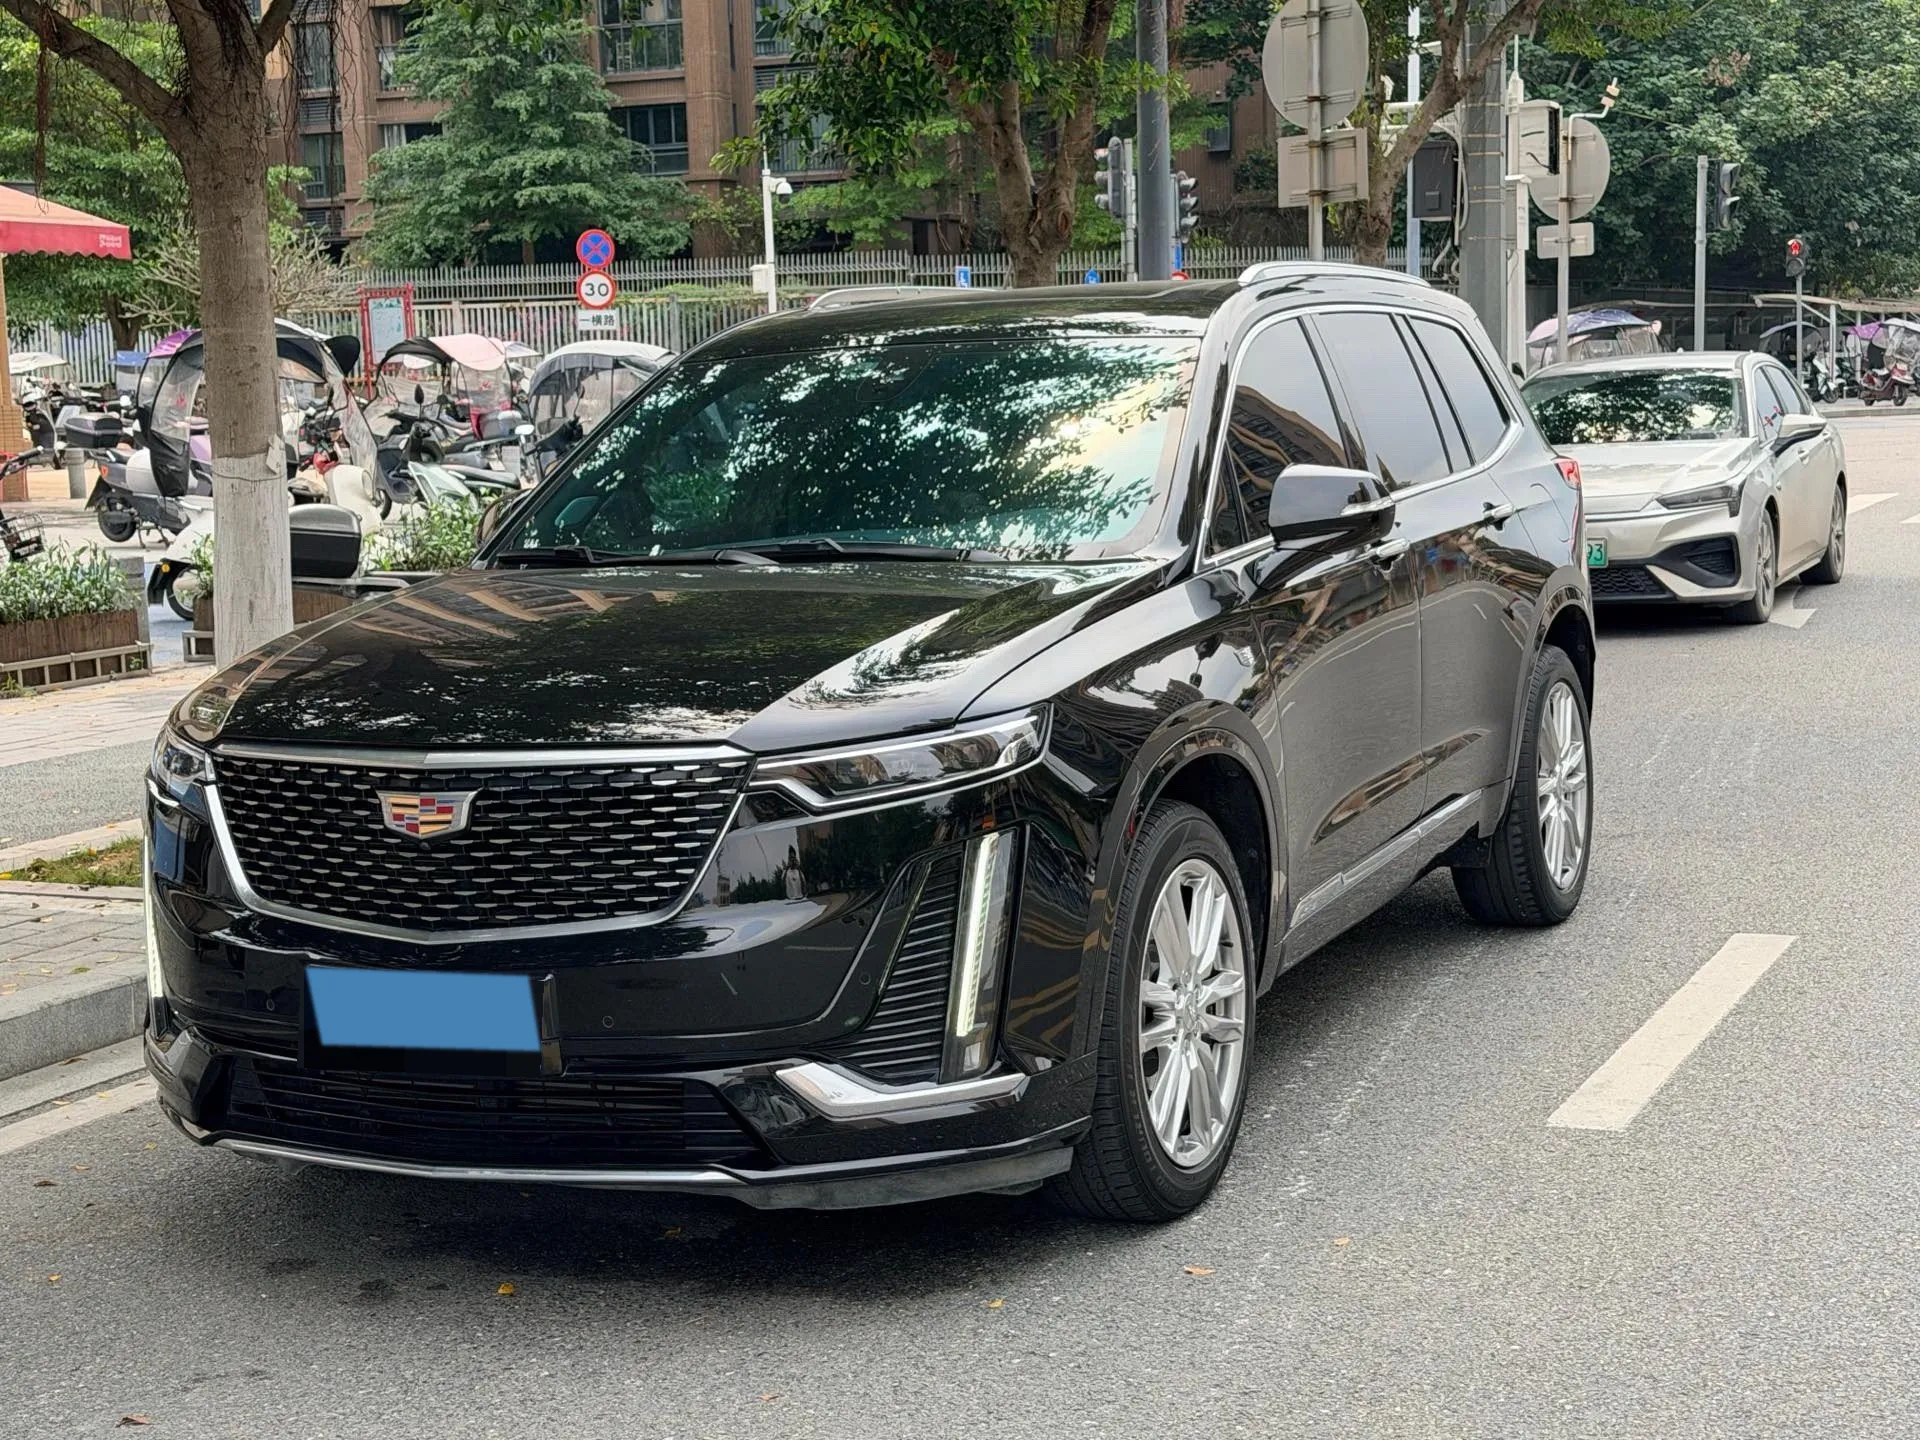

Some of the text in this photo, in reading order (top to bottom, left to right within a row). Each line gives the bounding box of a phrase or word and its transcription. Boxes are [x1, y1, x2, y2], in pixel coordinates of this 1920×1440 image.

[584, 283, 610, 297] 30
[579, 314, 615, 327] 一横路
